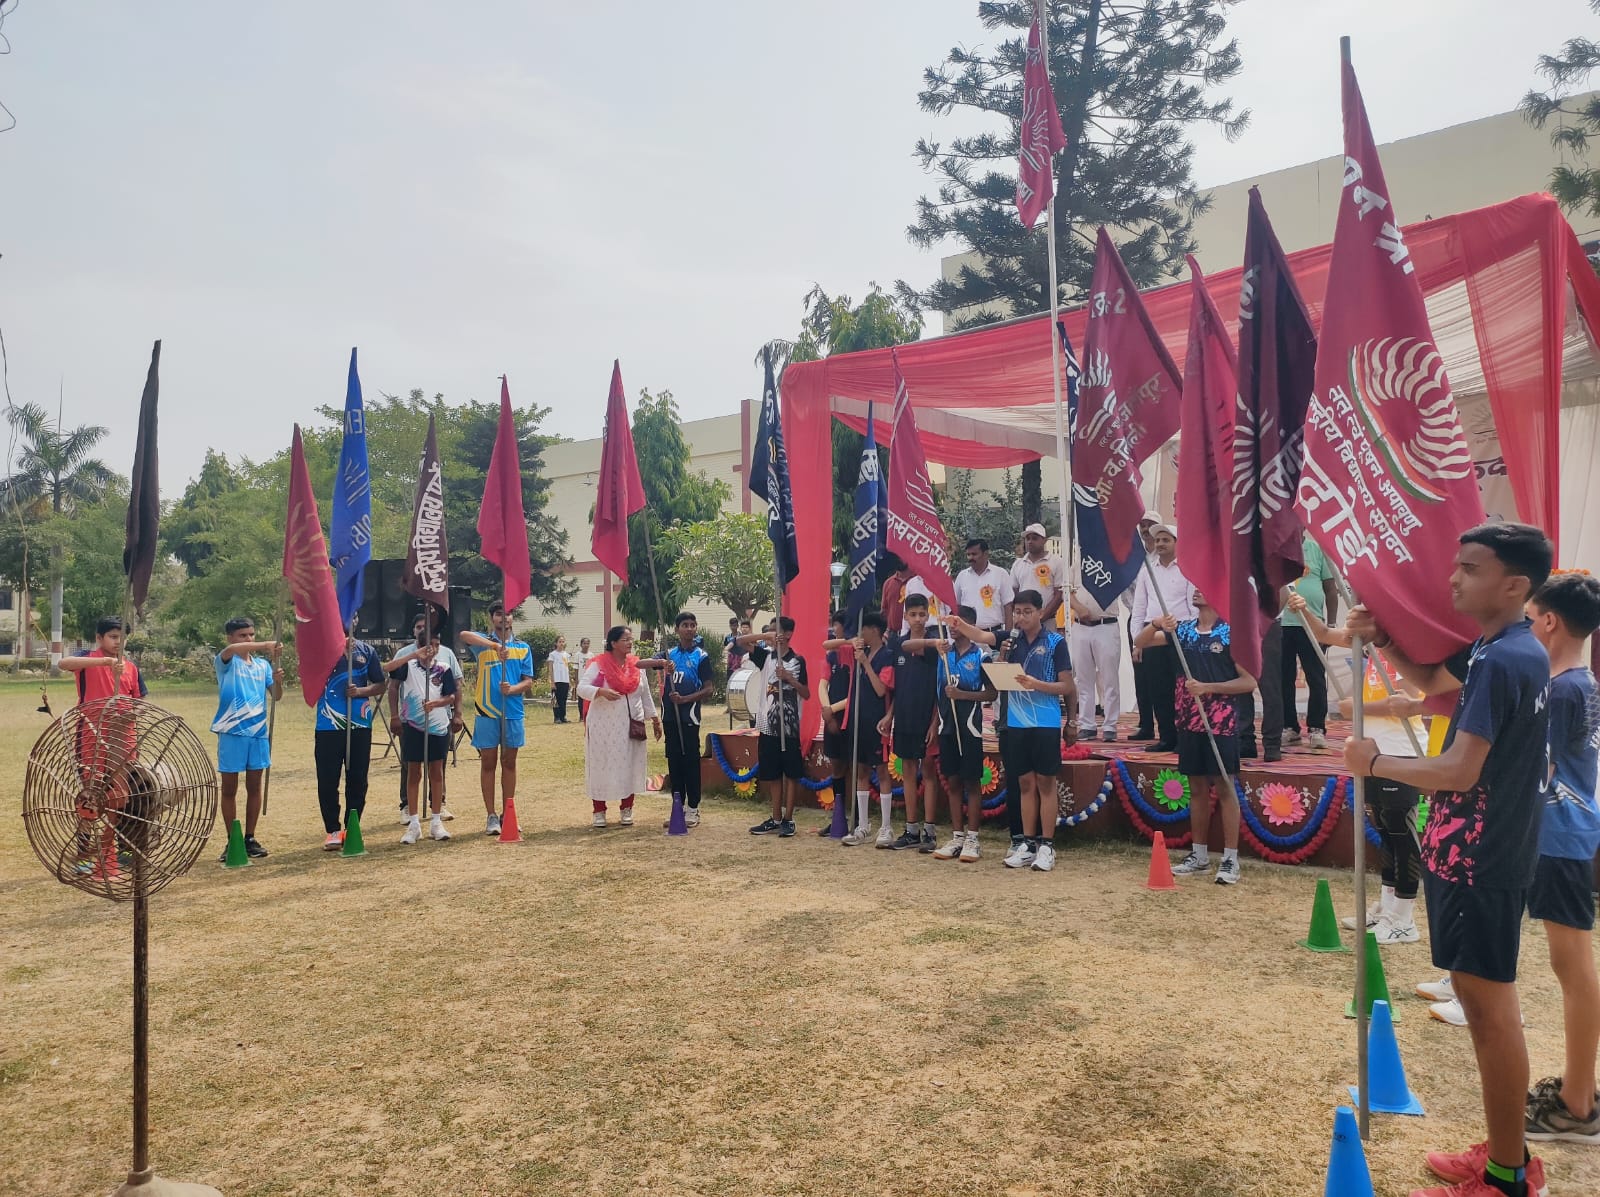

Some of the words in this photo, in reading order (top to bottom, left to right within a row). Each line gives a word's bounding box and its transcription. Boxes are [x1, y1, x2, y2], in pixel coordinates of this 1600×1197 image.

[1113, 288, 1127, 314] 2
[413, 492, 443, 549] विद्यालय
[1379, 478, 1423, 536] अपावृणु
[887, 512, 932, 553] लखनऊ
[1370, 507, 1413, 563] संगठन
[1082, 556, 1111, 587] खीरी
